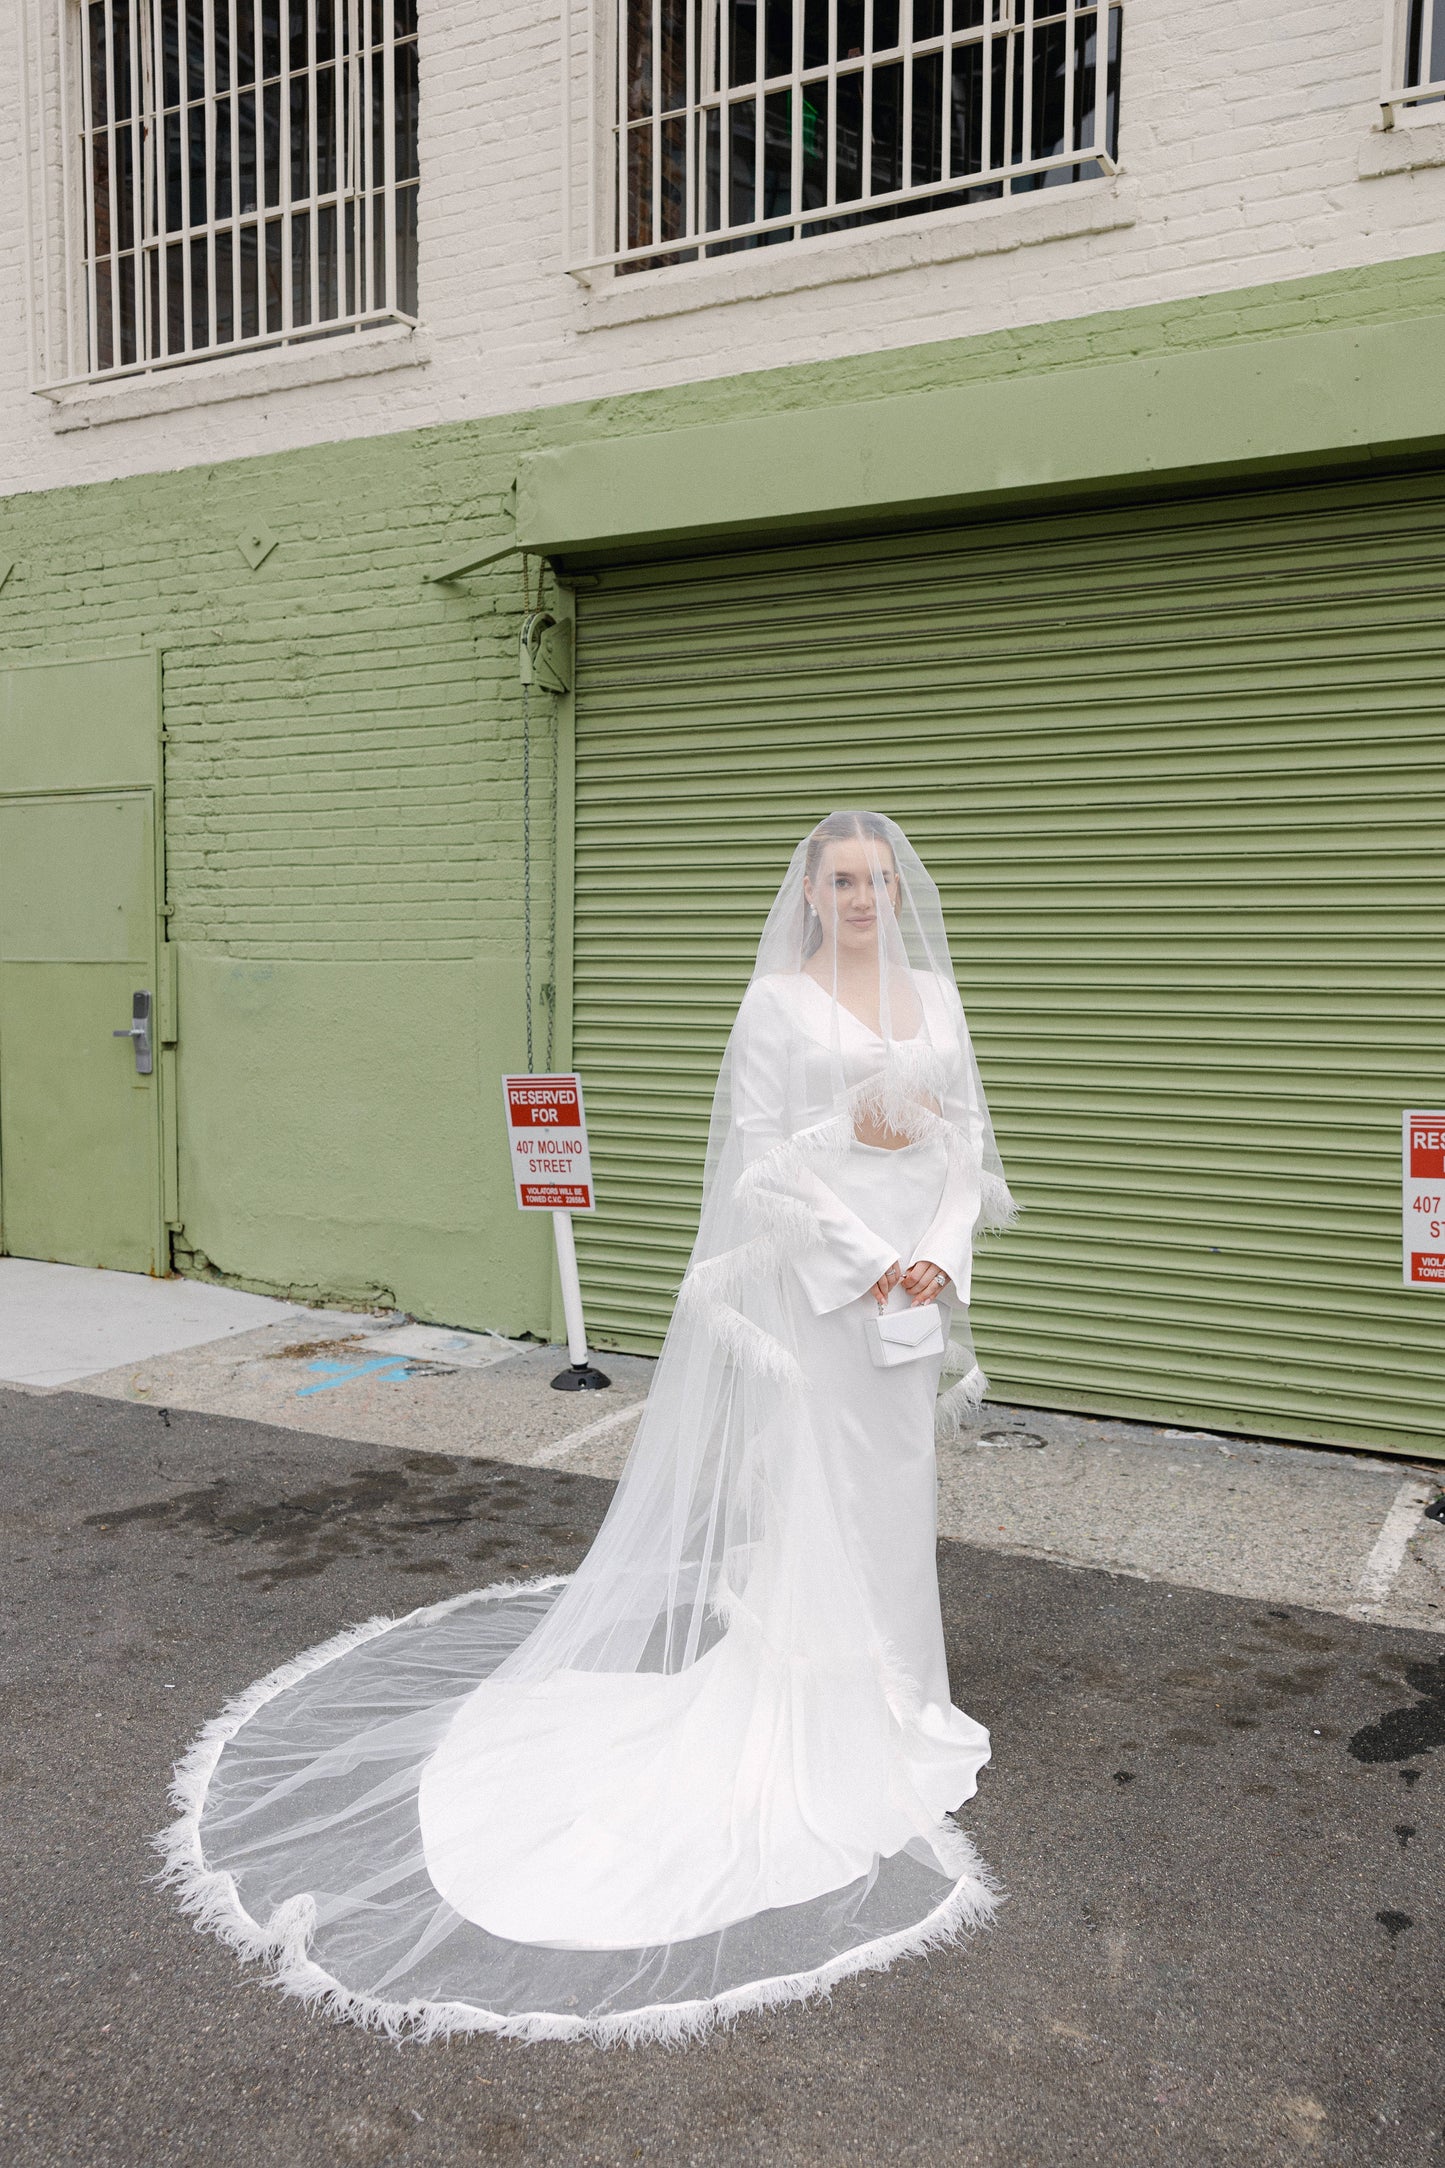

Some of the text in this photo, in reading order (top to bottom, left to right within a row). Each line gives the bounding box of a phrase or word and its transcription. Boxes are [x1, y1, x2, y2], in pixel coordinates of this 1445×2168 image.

[510, 1090, 575, 1105] RESERVED
[531, 1108, 559, 1123] FOR
[516, 1140, 583, 1154] 407 MOLINO
[529, 1159, 572, 1173] STREET
[526, 1187, 583, 1196] VIOLATORS WILL BE
[525, 1195, 547, 1203] TOWED
[1412, 1196, 1441, 1214] 407
